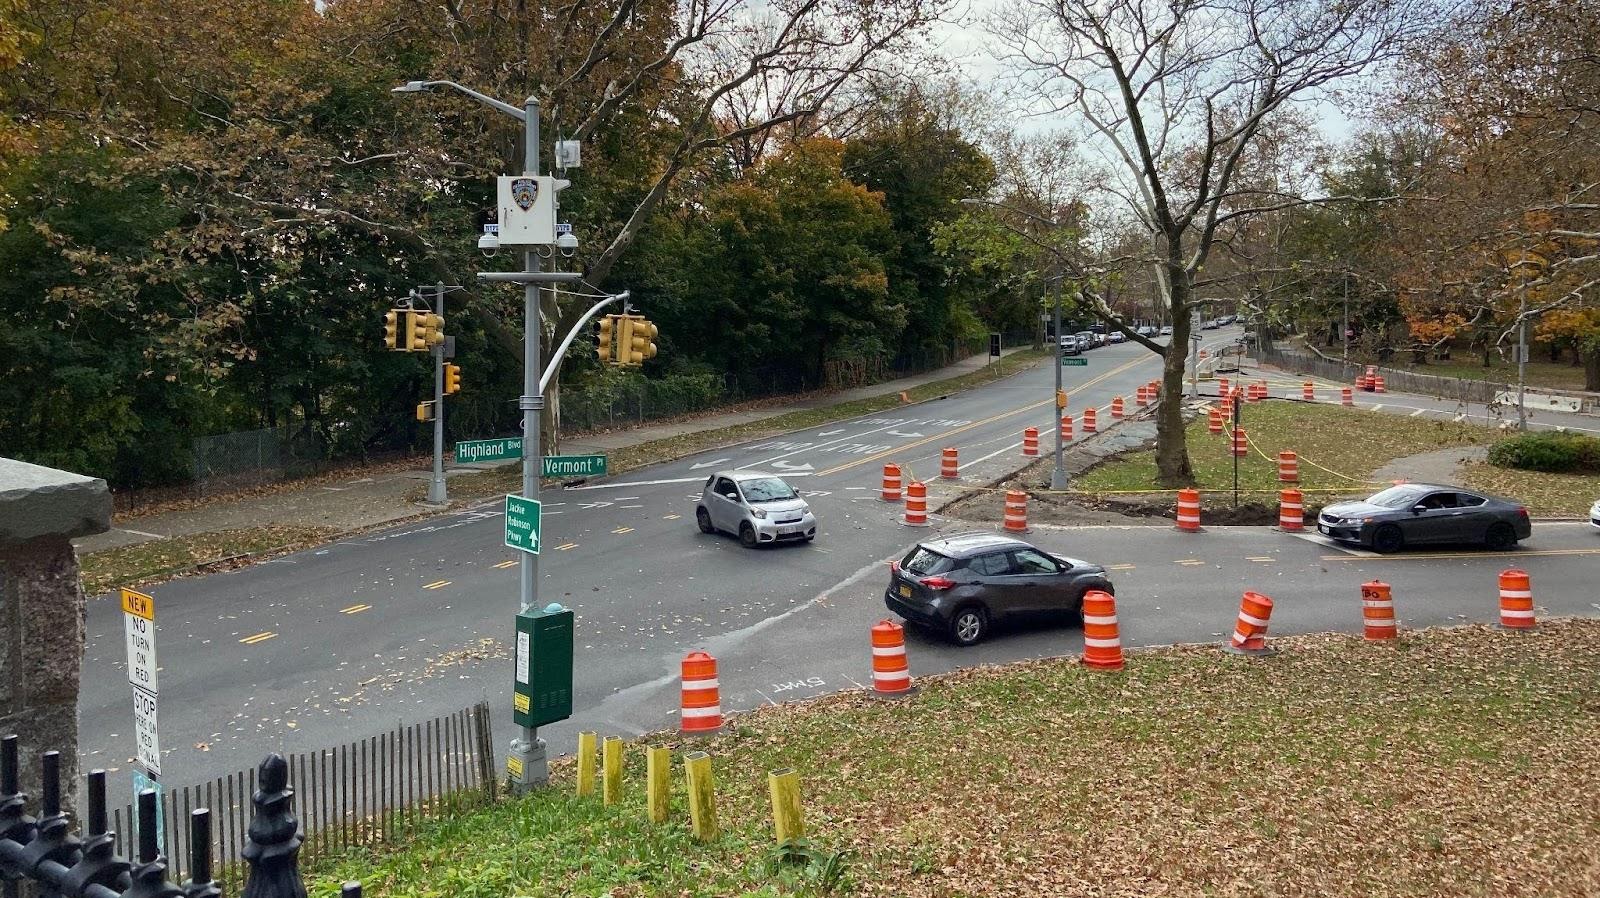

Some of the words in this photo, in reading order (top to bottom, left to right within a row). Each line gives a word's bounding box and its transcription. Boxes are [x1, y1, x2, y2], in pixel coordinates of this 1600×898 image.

[459, 443, 504, 462] Highland
[507, 440, 521, 450] Blvd
[545, 459, 592, 473] Vermont
[596, 458, 604, 466] Pl
[508, 502, 525, 515] Jackie
[508, 515, 531, 530] Robinson
[508, 530, 522, 544] Pkwy
[128, 595, 147, 613] NEW
[132, 616, 146, 633] NO
[132, 634, 150, 652] TURN
[136, 652, 146, 665] ON
[135, 667, 149, 683] RED
[135, 692, 155, 718] STOP
[141, 731, 152, 748] RED
